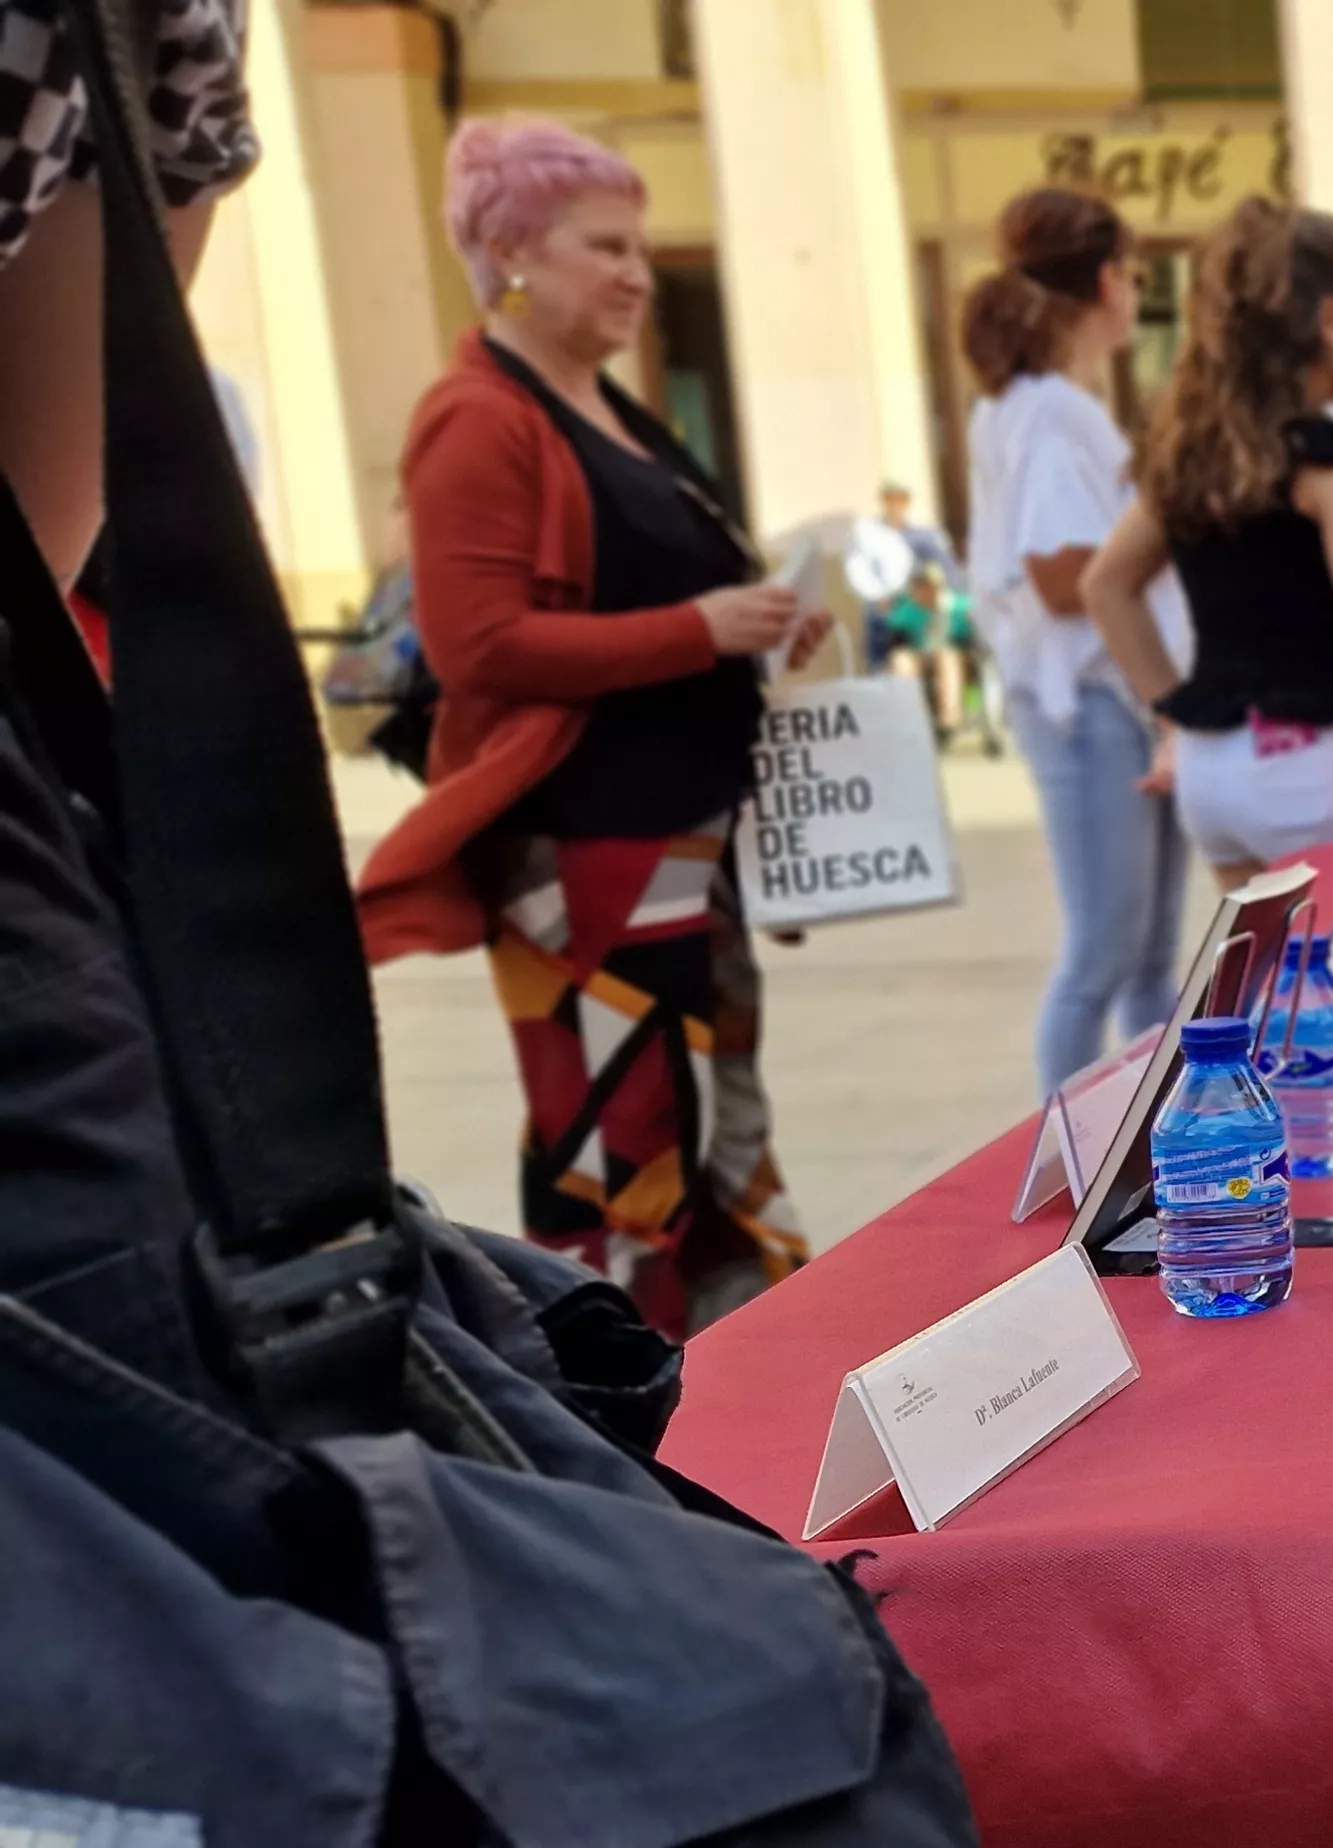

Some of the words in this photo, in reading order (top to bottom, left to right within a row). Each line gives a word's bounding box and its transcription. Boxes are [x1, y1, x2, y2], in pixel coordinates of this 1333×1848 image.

[752, 747, 822, 786] DEL
[754, 776, 872, 823] LIBRO
[757, 821, 809, 861] DE
[761, 844, 932, 899] HUESCA
[989, 1385, 1023, 1415] Blanca
[1020, 1359, 1059, 1392] Lafuente
